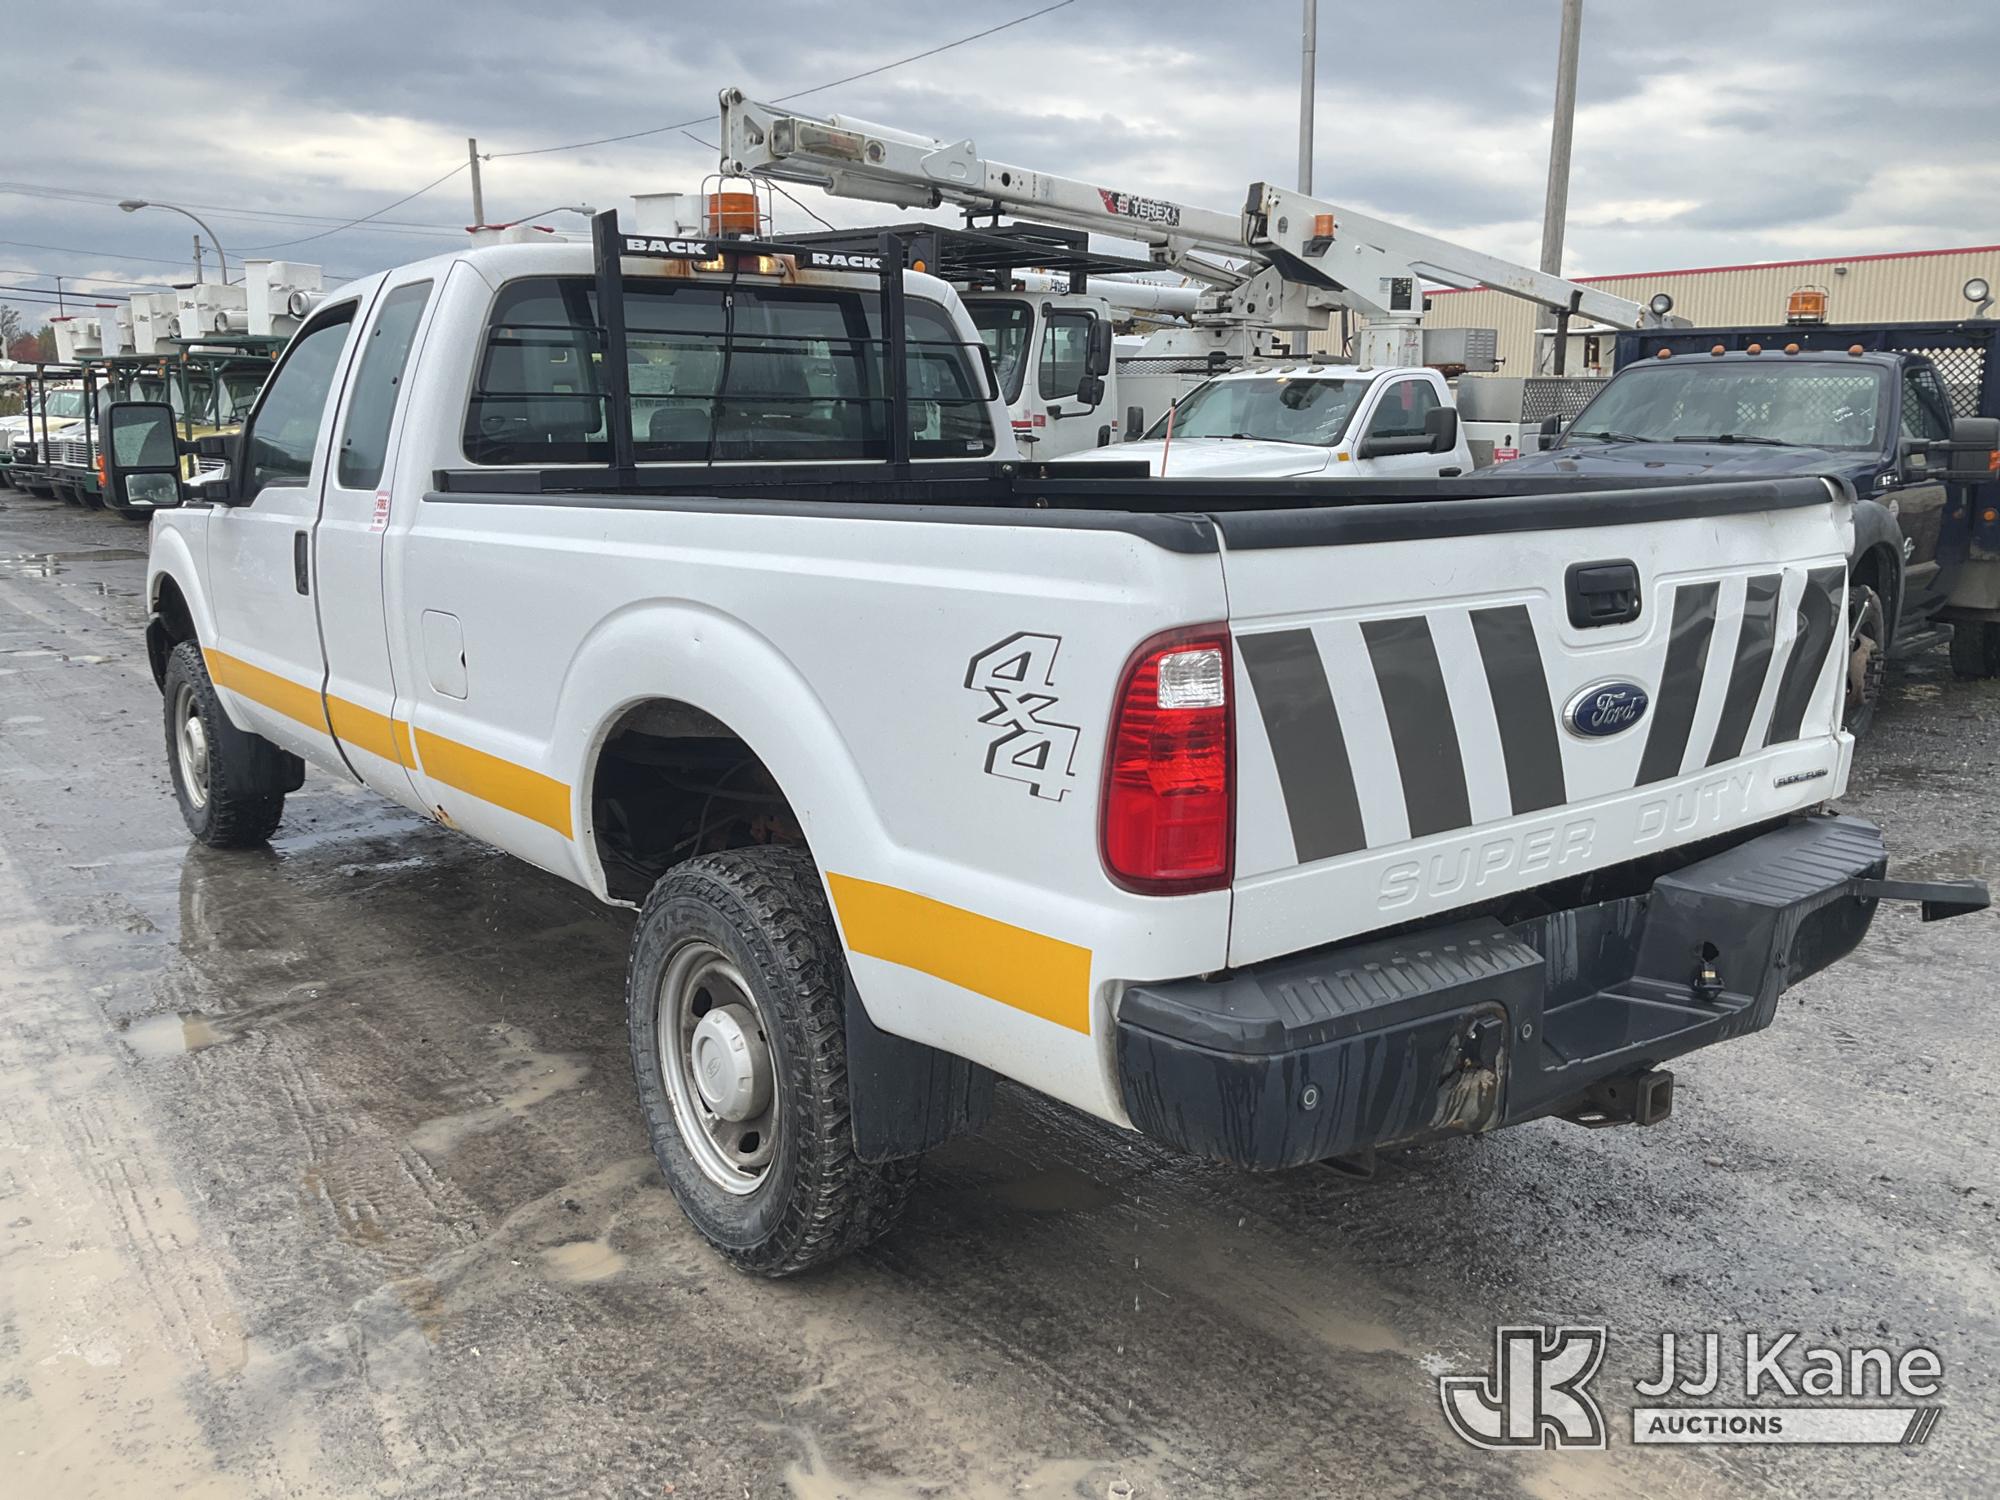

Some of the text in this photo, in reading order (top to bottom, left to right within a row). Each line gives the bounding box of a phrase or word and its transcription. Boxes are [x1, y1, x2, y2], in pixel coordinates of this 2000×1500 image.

[1132, 200, 1172, 222] TEREX
[626, 238, 882, 269] BACK RACK
[1591, 691, 1646, 727] Ford
[1377, 771, 1755, 911] SUPER DUTY
